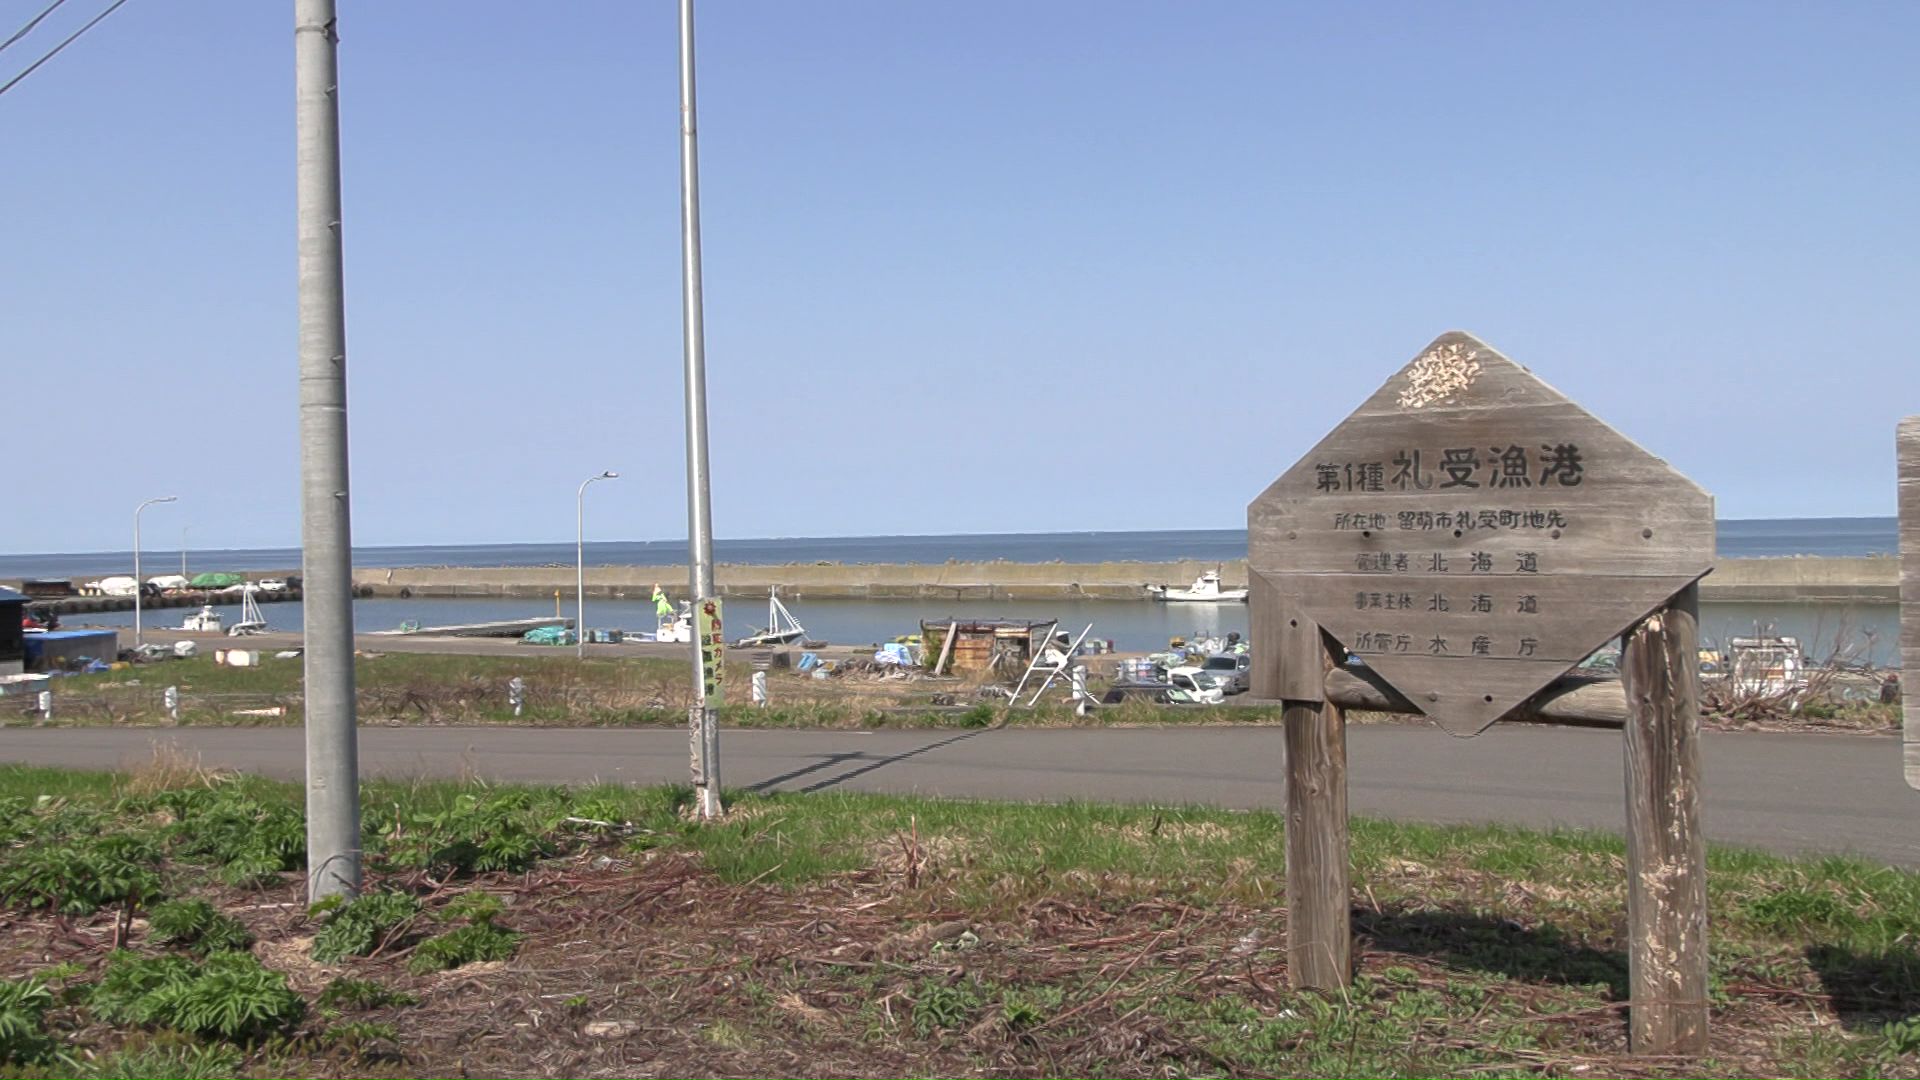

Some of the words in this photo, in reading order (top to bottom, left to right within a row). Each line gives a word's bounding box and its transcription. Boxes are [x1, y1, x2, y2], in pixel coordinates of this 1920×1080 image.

[1391, 443, 1584, 490] 礼受漁港
[1428, 551, 1539, 573] 北海道
[1428, 593, 1539, 614] 北海道
[1428, 634, 1539, 657] 水産庁
